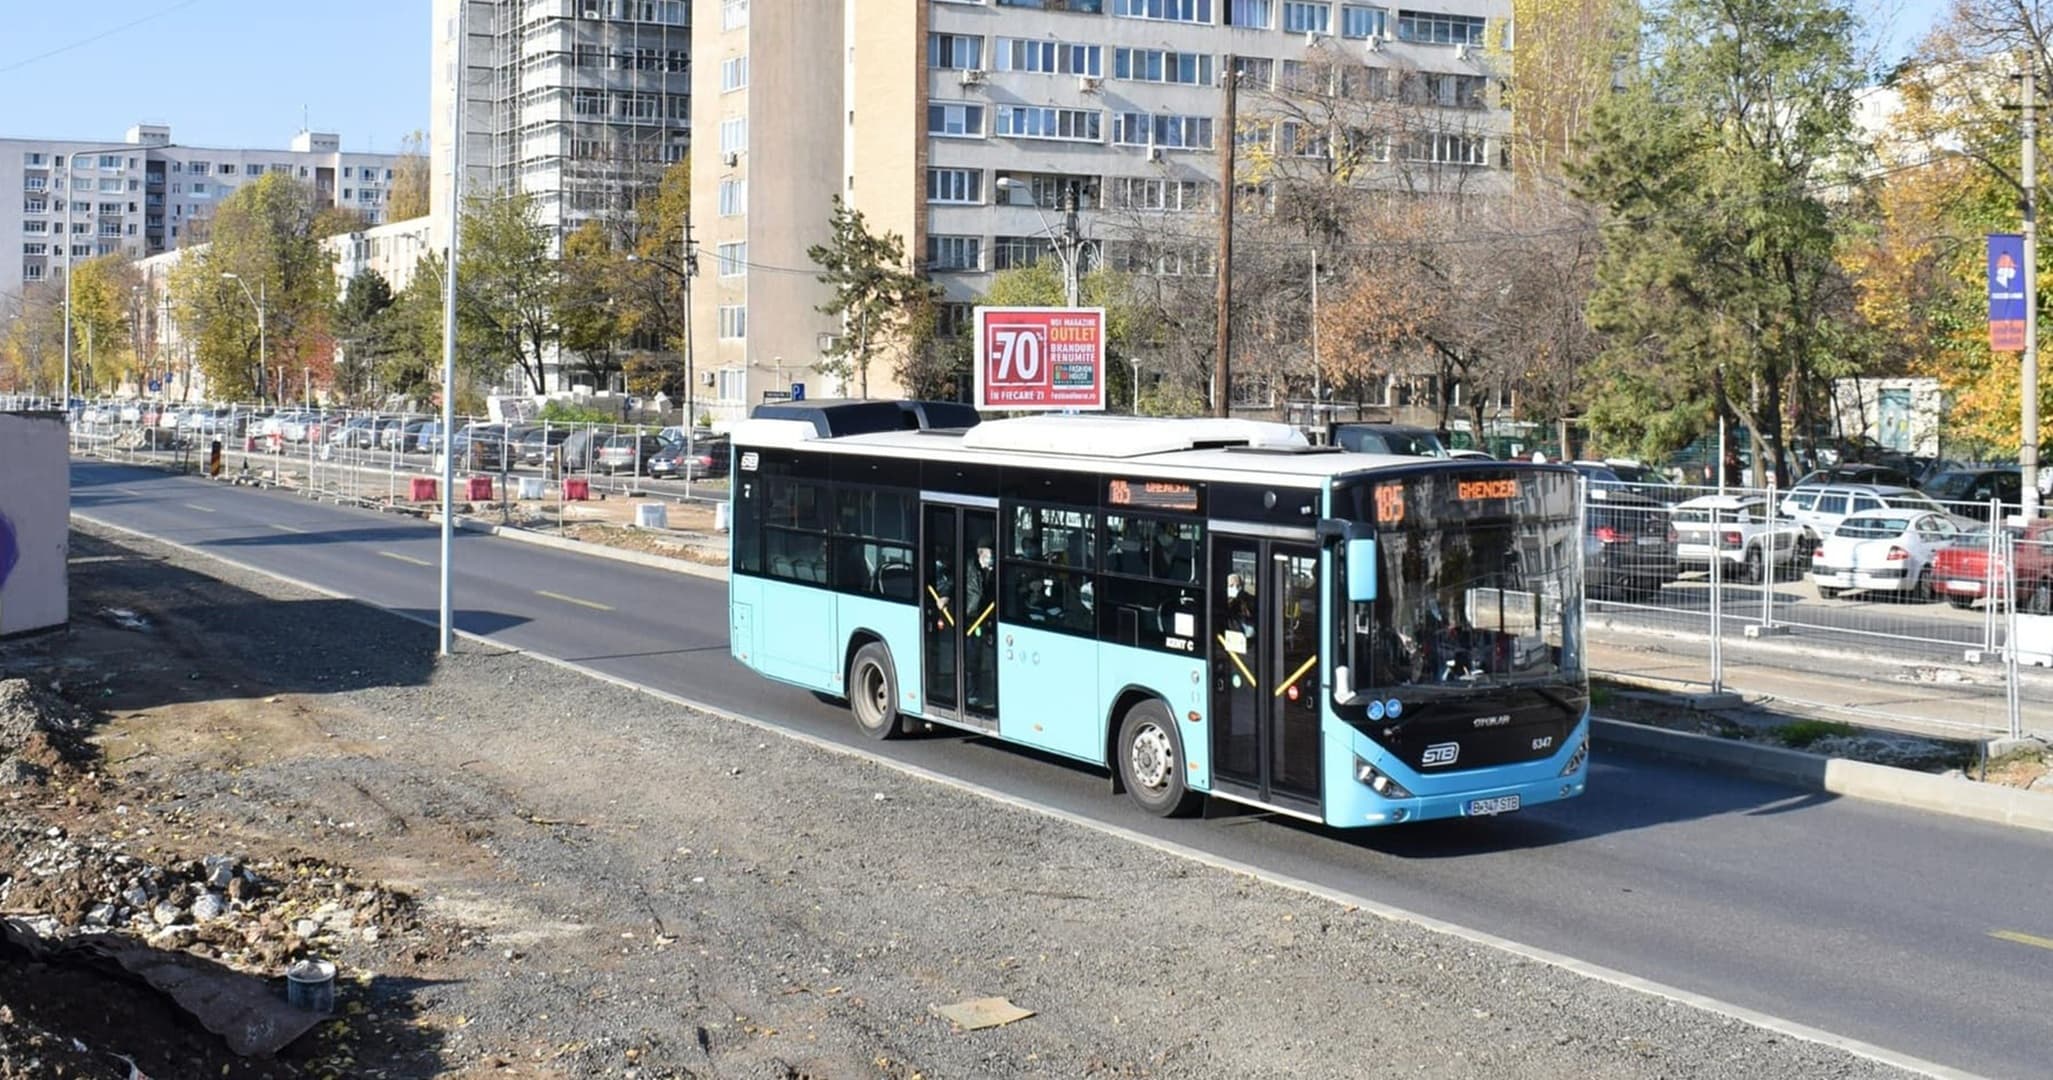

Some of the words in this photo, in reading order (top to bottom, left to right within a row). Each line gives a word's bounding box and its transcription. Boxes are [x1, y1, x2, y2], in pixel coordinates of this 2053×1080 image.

[1050, 327, 1096, 341] OUTLET
[1050, 344, 1095, 352] BRANDURI
[1050, 353, 1095, 361] RENUMITE
[1001, 391, 1033, 400] FIECARE
[1037, 391, 1045, 400] ZI
[1375, 485, 1404, 522] 185
[1458, 480, 1516, 499] GHENCEA
[1187, 640, 1194, 651] C
[1473, 715, 1511, 727] OTOKAR
[1532, 736, 1552, 750] 6347
[1422, 746, 1456, 763] STB
